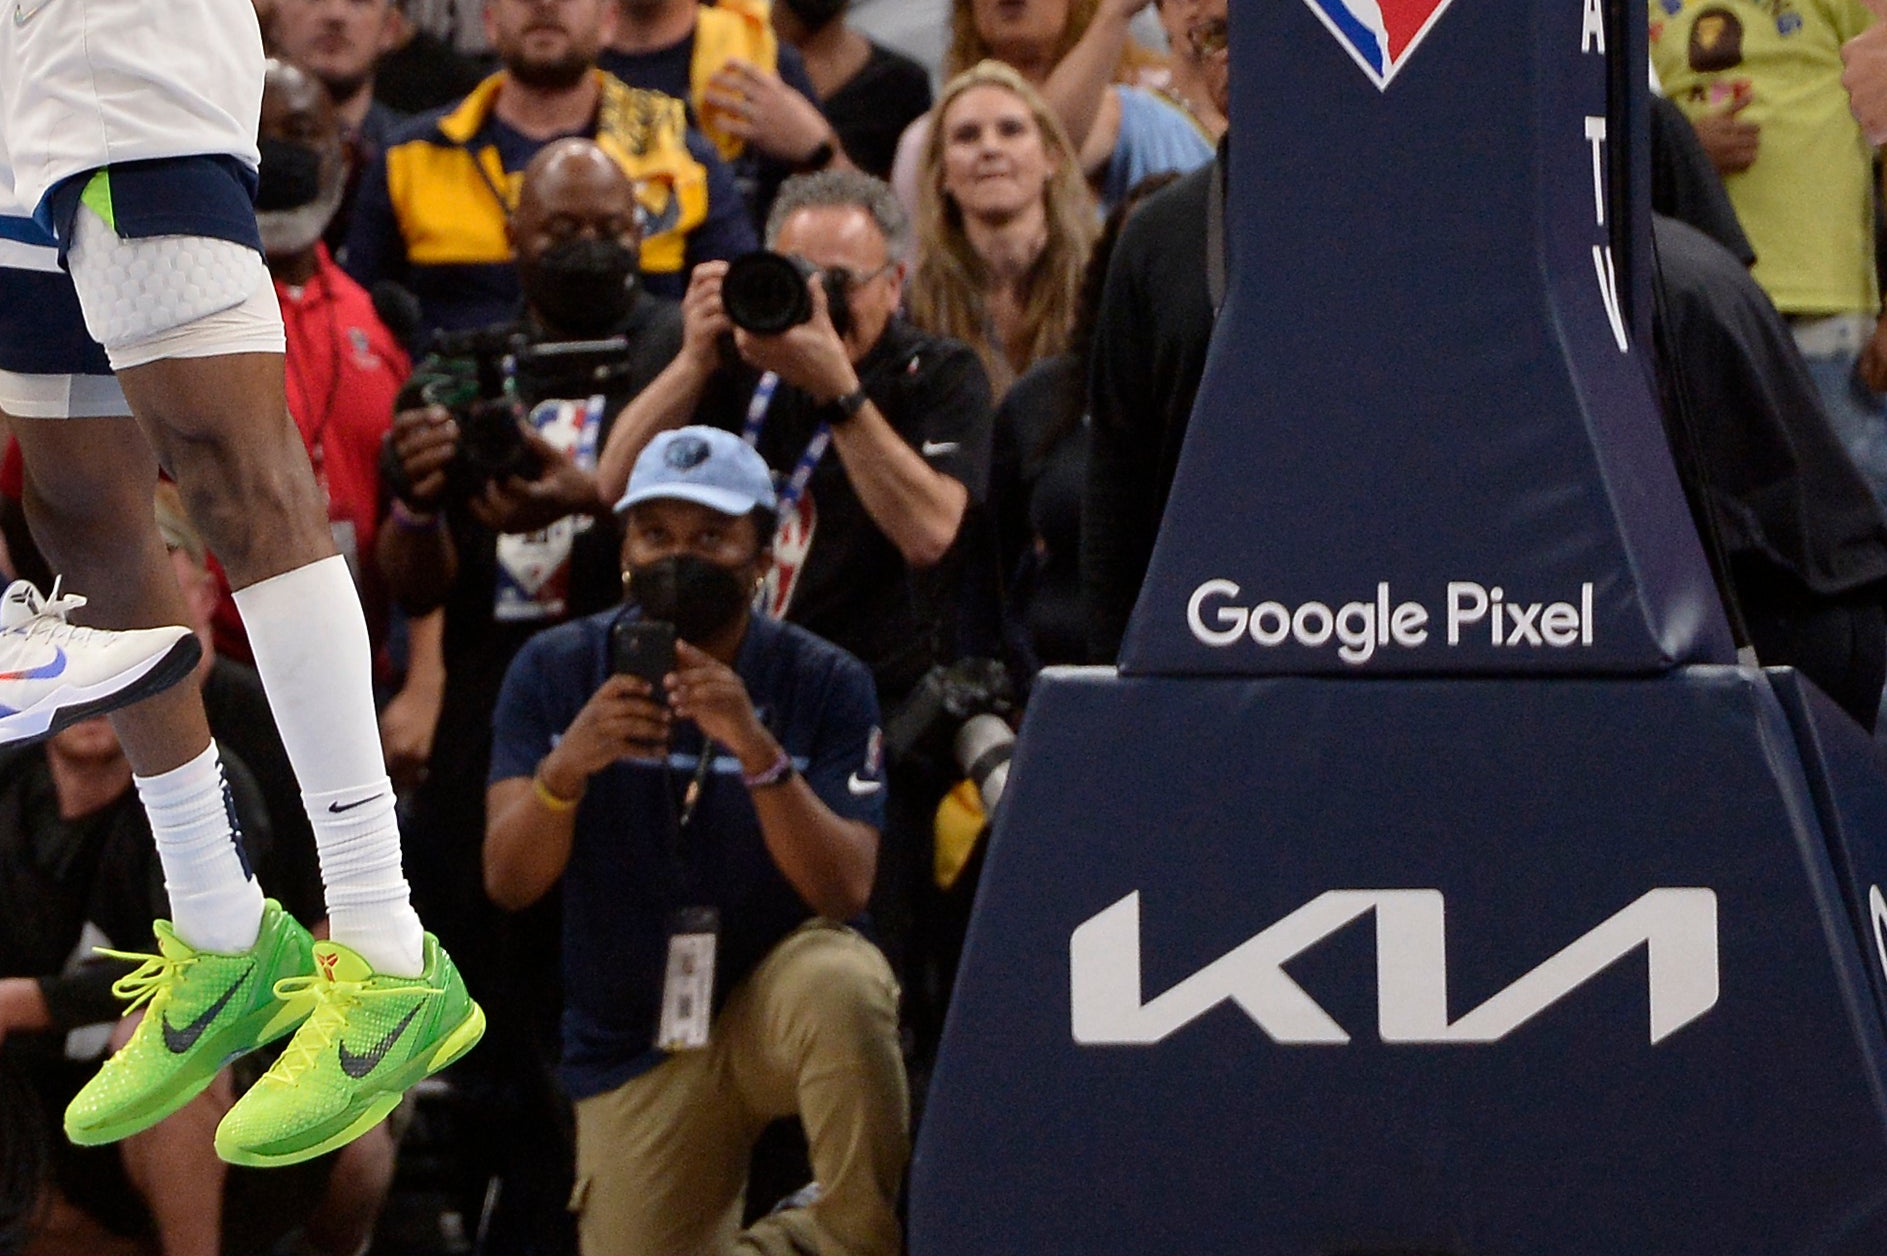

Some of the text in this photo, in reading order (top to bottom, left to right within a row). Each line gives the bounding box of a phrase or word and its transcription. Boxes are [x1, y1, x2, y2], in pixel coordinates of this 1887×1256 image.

[1186, 578, 1594, 664] Google Pixel
[1069, 886, 1720, 1046] KIA
